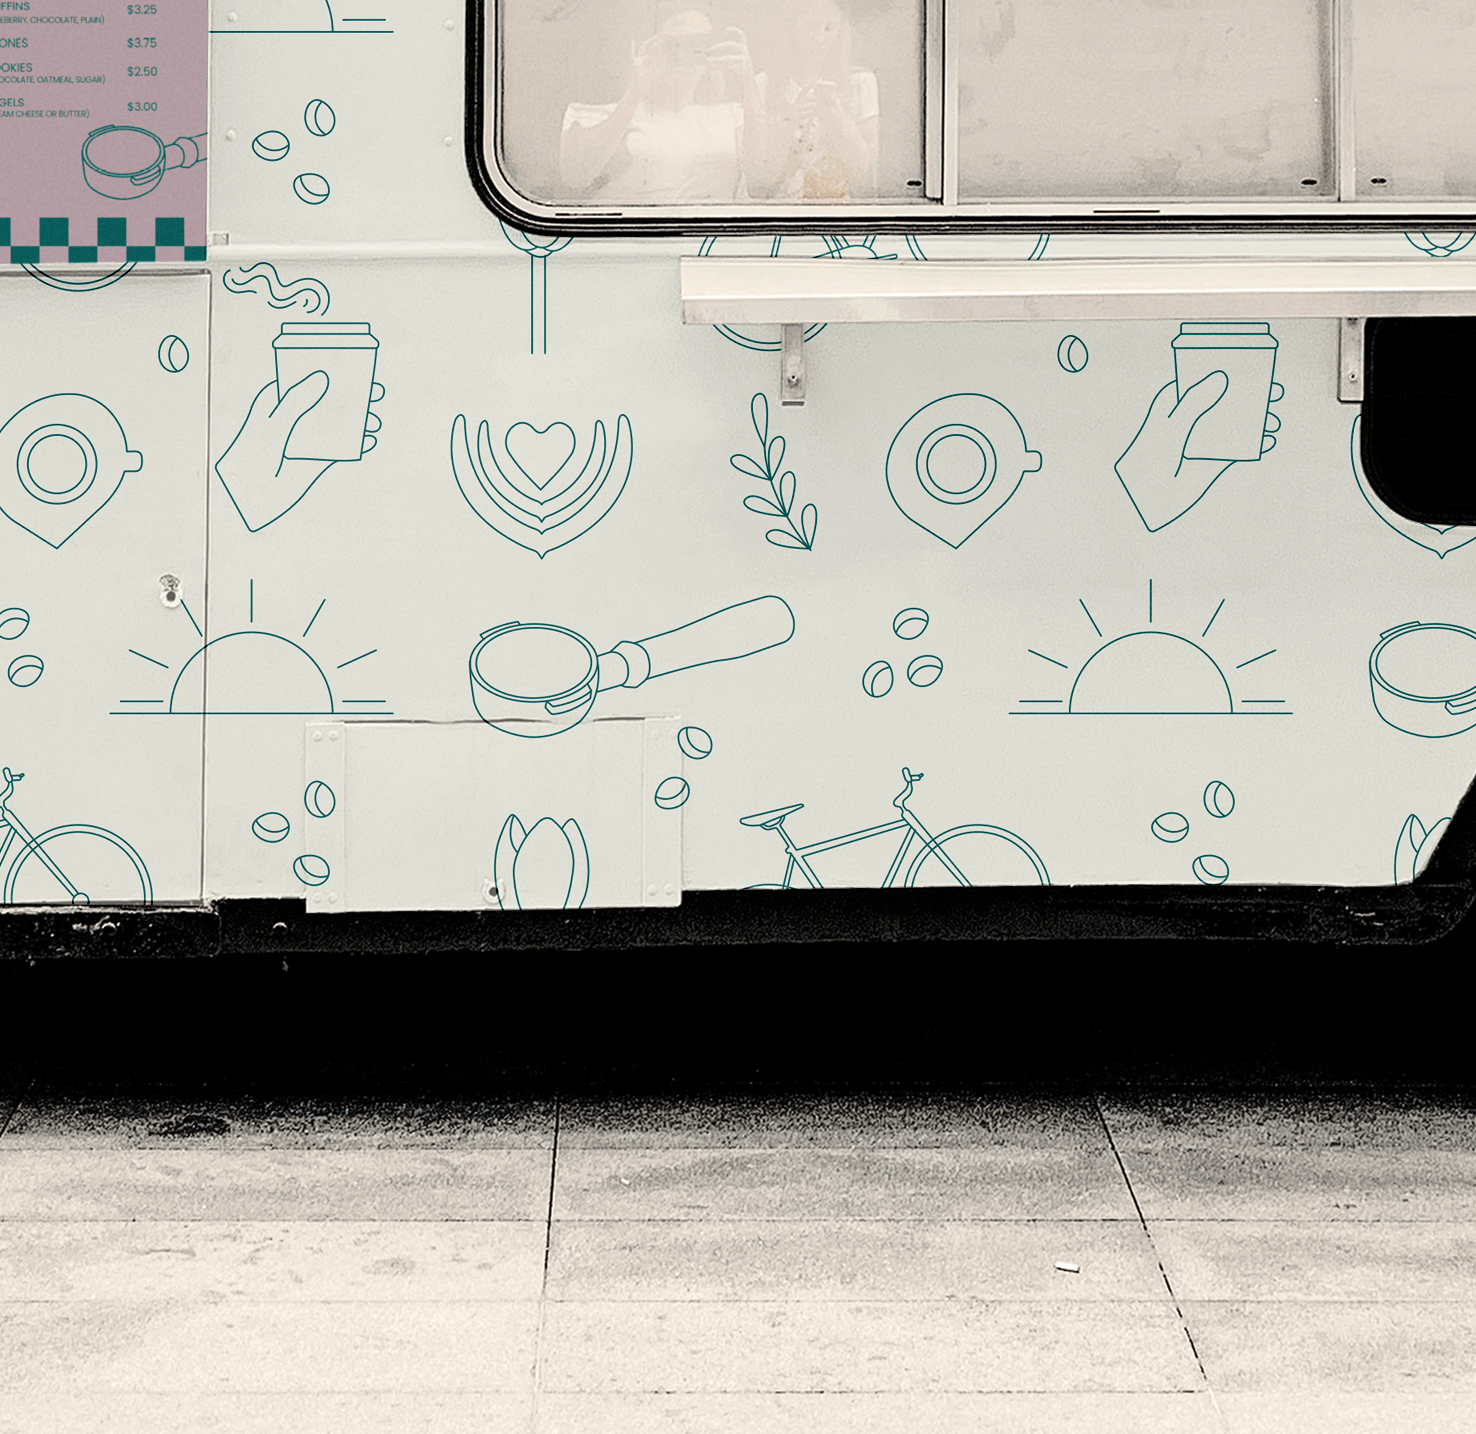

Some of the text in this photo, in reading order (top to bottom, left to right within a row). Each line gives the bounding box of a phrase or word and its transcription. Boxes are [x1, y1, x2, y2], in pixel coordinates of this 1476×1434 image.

[126, 4, 158, 16] $3.25
[126, 36, 158, 49] $3.75
[126, 65, 158, 78] $2.50
[126, 101, 158, 112] $3.00
